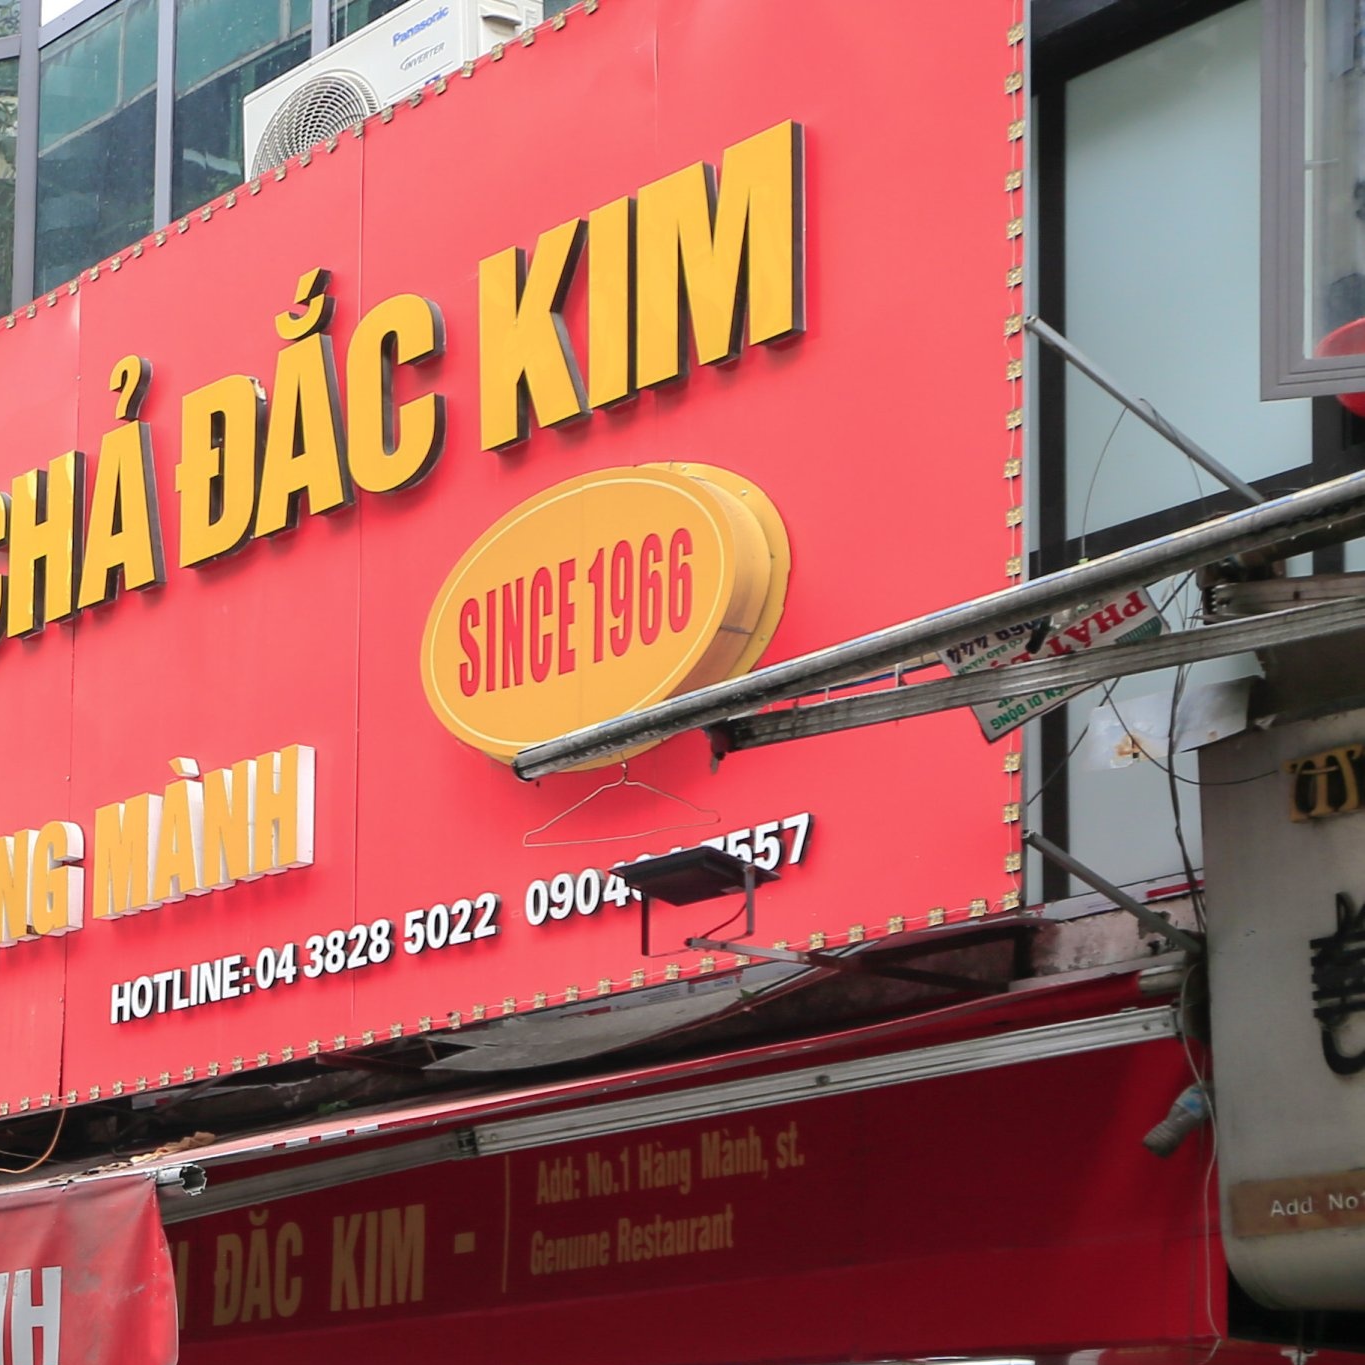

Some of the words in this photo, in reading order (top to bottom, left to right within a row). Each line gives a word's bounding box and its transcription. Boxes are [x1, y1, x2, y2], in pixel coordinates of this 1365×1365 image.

[392, 6, 449, 47] Panasonic
[174, 267, 446, 569] ĐẮC
[478, 118, 807, 452] KIM
[458, 556, 577, 698] SINCE
[586, 527, 694, 664] 1966
[92, 743, 315, 920] MÀNH
[303, 918, 393, 979] 3828
[403, 891, 500, 956] 5022
[536, 1156, 581, 1205] Add:
[587, 1146, 630, 1198] No.1
[639, 1141, 692, 1195] Hàng
[701, 1125, 769, 1179] Mành,
[776, 1120, 805, 1170] st.
[330, 1203, 426, 1312] KIM
[617, 1202, 735, 1264] Restaurant
